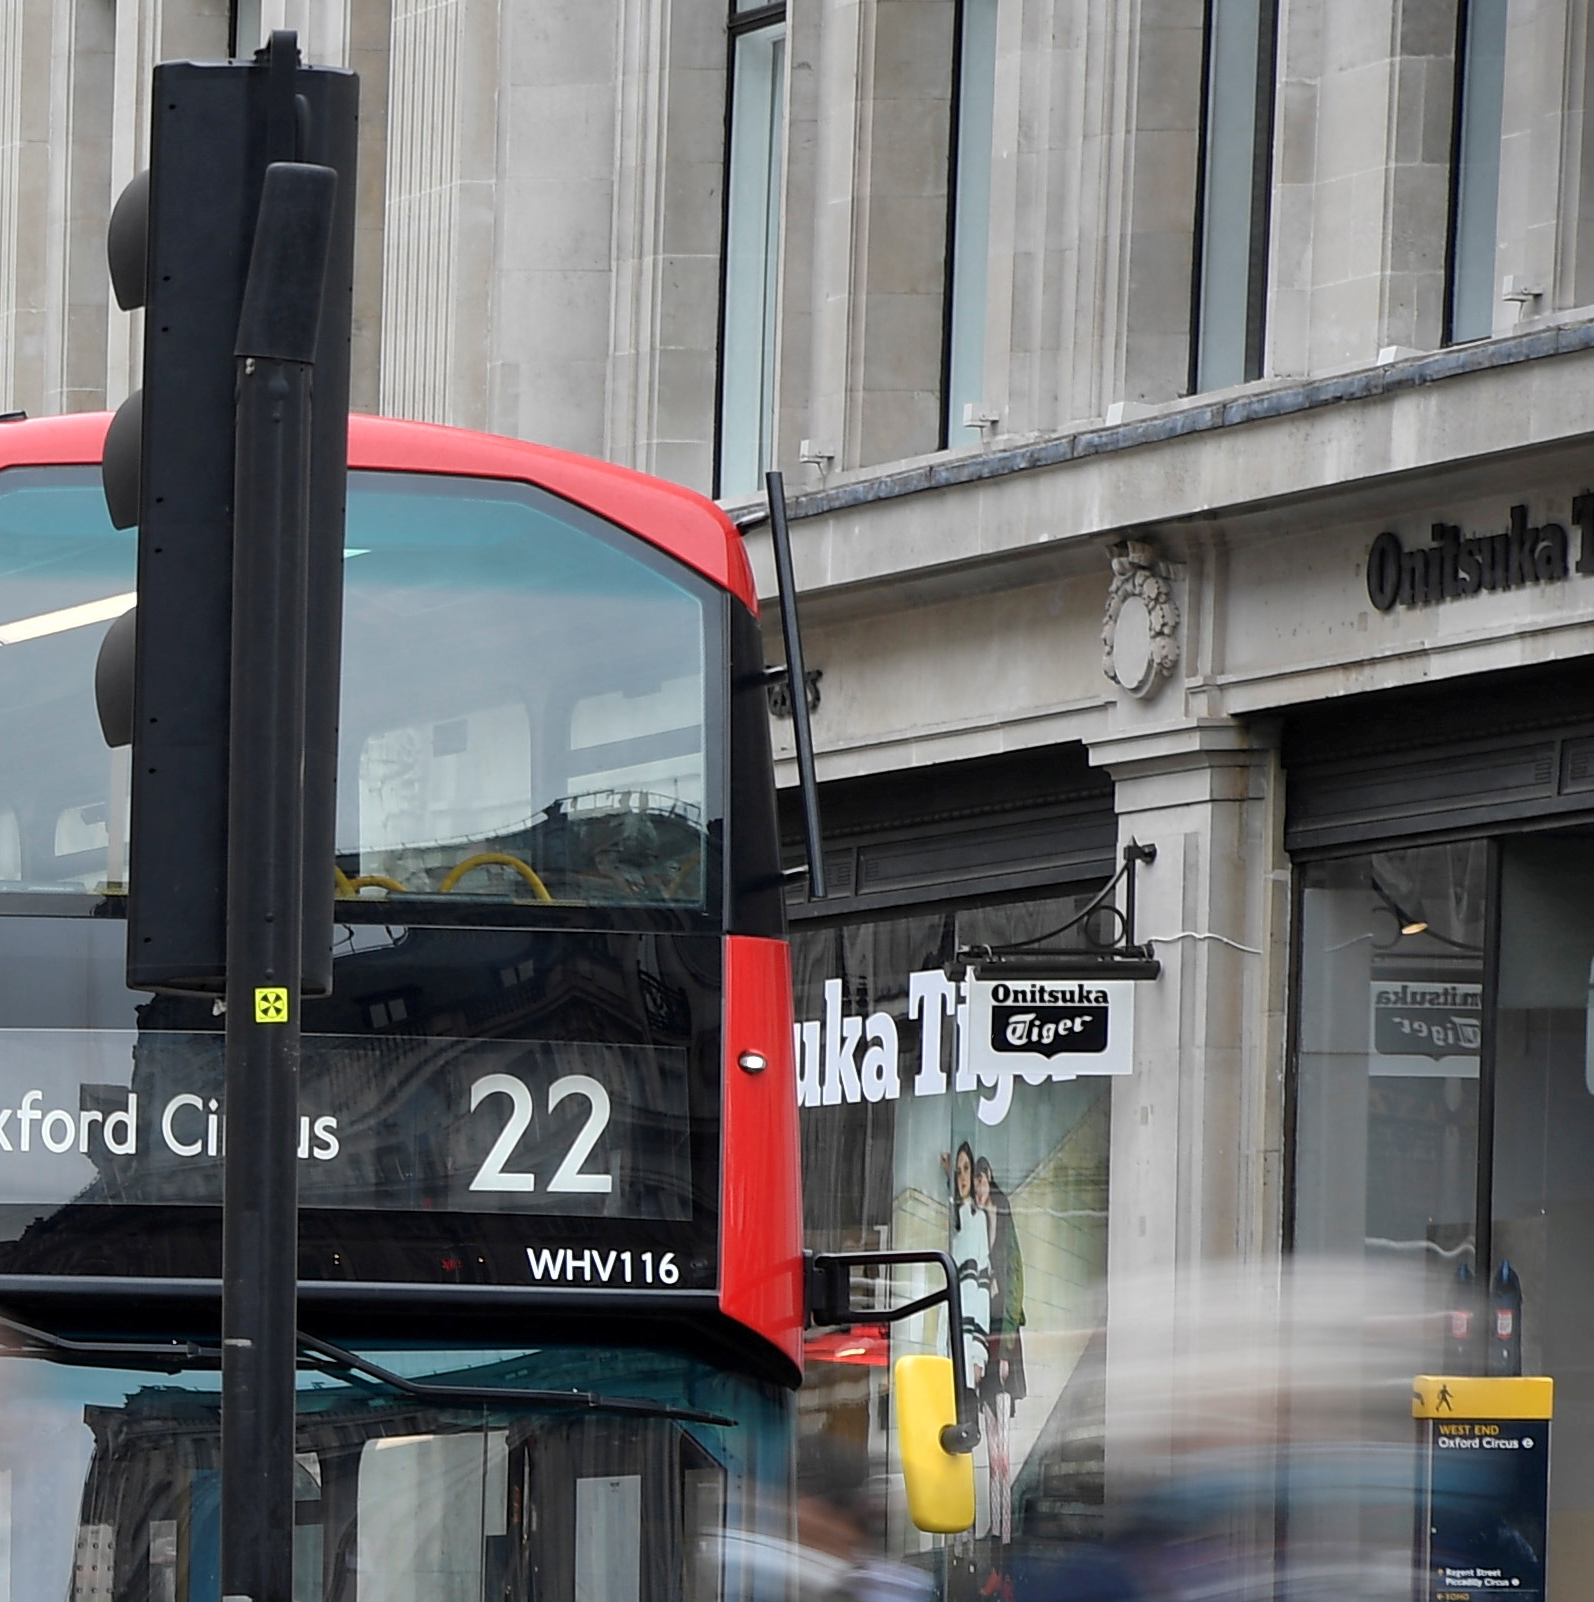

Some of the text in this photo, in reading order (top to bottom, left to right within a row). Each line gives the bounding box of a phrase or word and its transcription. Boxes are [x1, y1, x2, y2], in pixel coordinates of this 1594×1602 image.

[1367, 505, 1569, 612] Onitsuka
[991, 984, 1109, 1005] Onitsuka
[1006, 1012, 1093, 1046] Tiger
[468, 1073, 613, 1193] 22
[526, 1247, 680, 1285] WHV116
[1438, 1424, 1500, 1436] WEST END
[1438, 1436, 1519, 1449] Oxford Circus
[1445, 1577, 1510, 1588] Piccadilly Circus
[1476, 1567, 1502, 1577] Street
